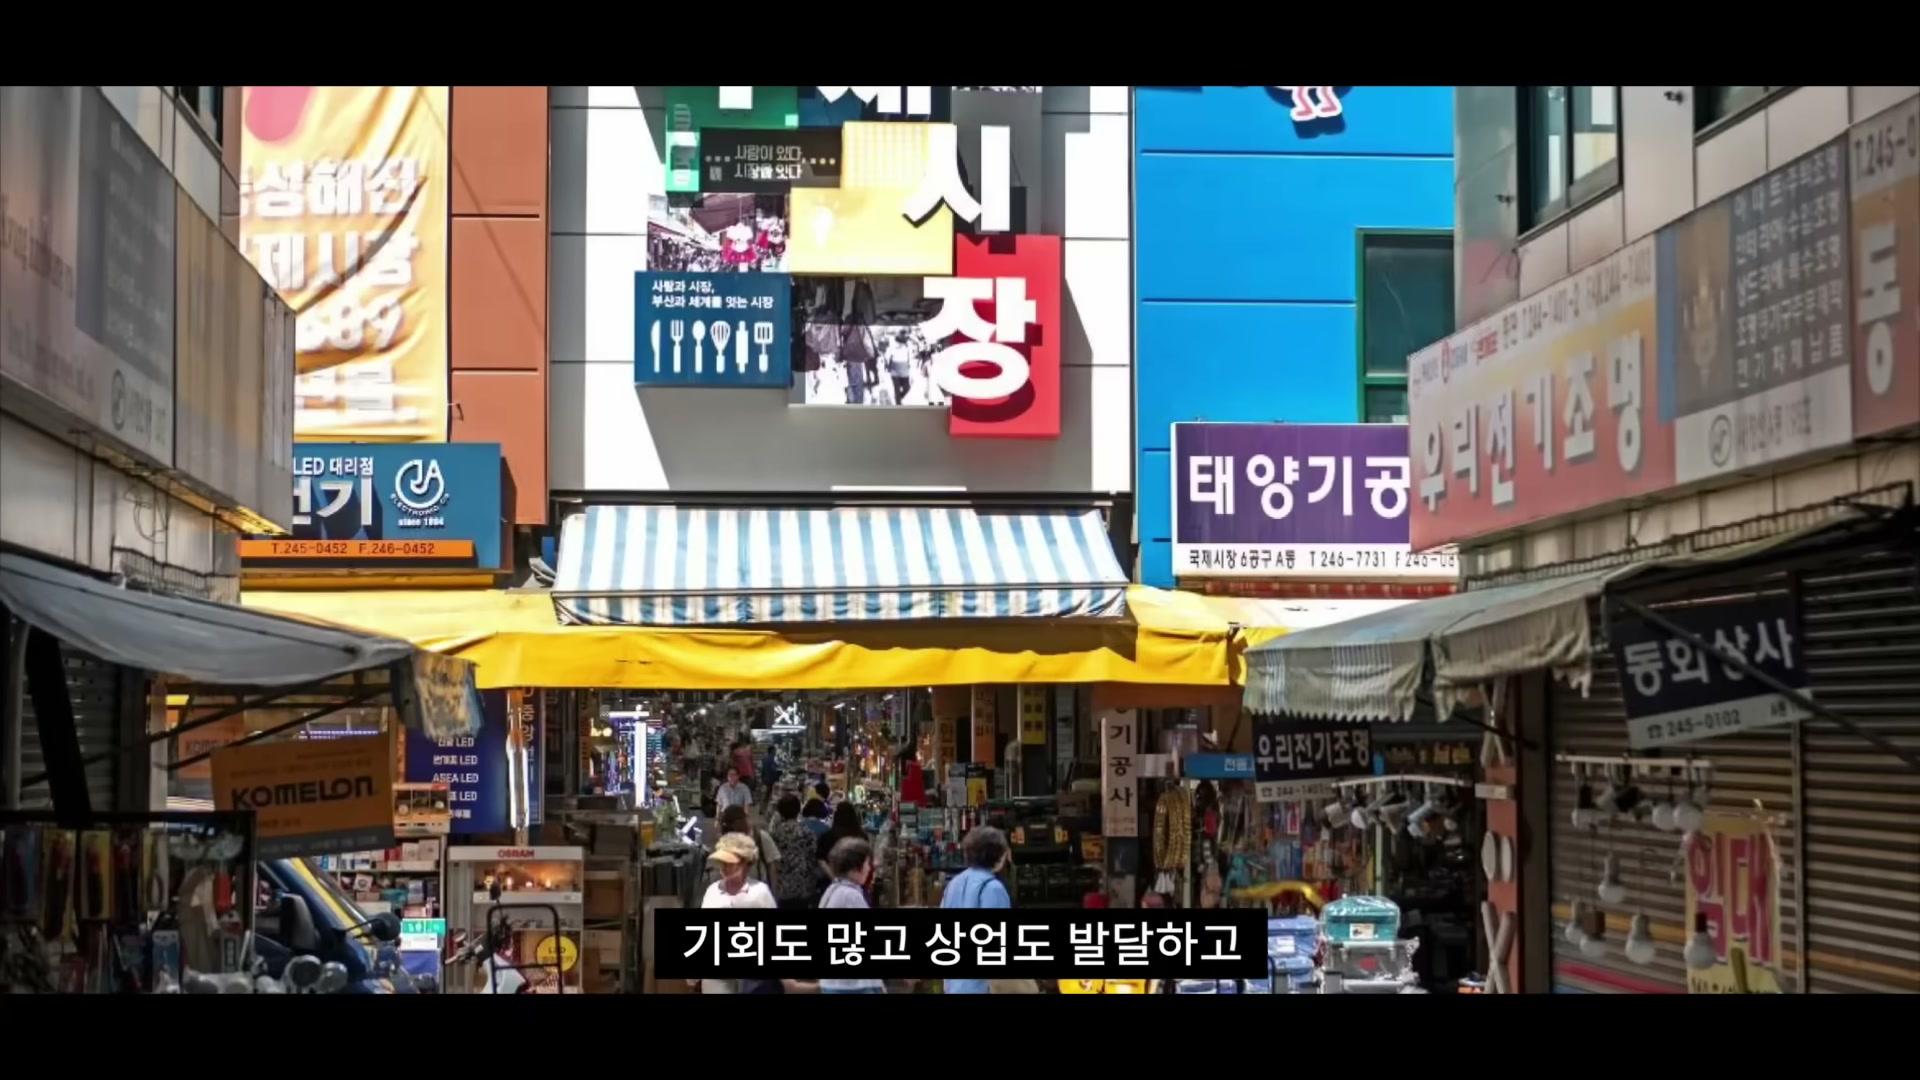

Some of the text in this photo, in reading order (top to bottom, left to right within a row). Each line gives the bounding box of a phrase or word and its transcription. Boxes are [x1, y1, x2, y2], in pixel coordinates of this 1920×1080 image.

[734, 144, 773, 161] 사람이
[240, 231, 420, 290] 제시장
[652, 295, 686, 309] 부산과
[688, 296, 722, 309] 세계를
[750, 296, 774, 309] 시장
[1420, 330, 1643, 512] 우리전기조명
[329, 457, 374, 476] 대리점
[271, 543, 435, 555] T.245-0452 F.246-0452
[1189, 549, 1237, 569] 국제시장
[1320, 551, 1387, 568] 246-7731
[1667, 708, 1741, 737] 245-0102
[456, 737, 475, 747] LED
[1257, 729, 1369, 772] 우리전기조명
[459, 755, 478, 765] LED
[1110, 706, 1134, 807] 기공사
[432, 773, 479, 783] ASEA LED
[232, 776, 373, 811] KOMELON
[459, 791, 478, 801] LED
[497, 849, 535, 858] OSRAM
[1688, 832, 1773, 964] 임대
